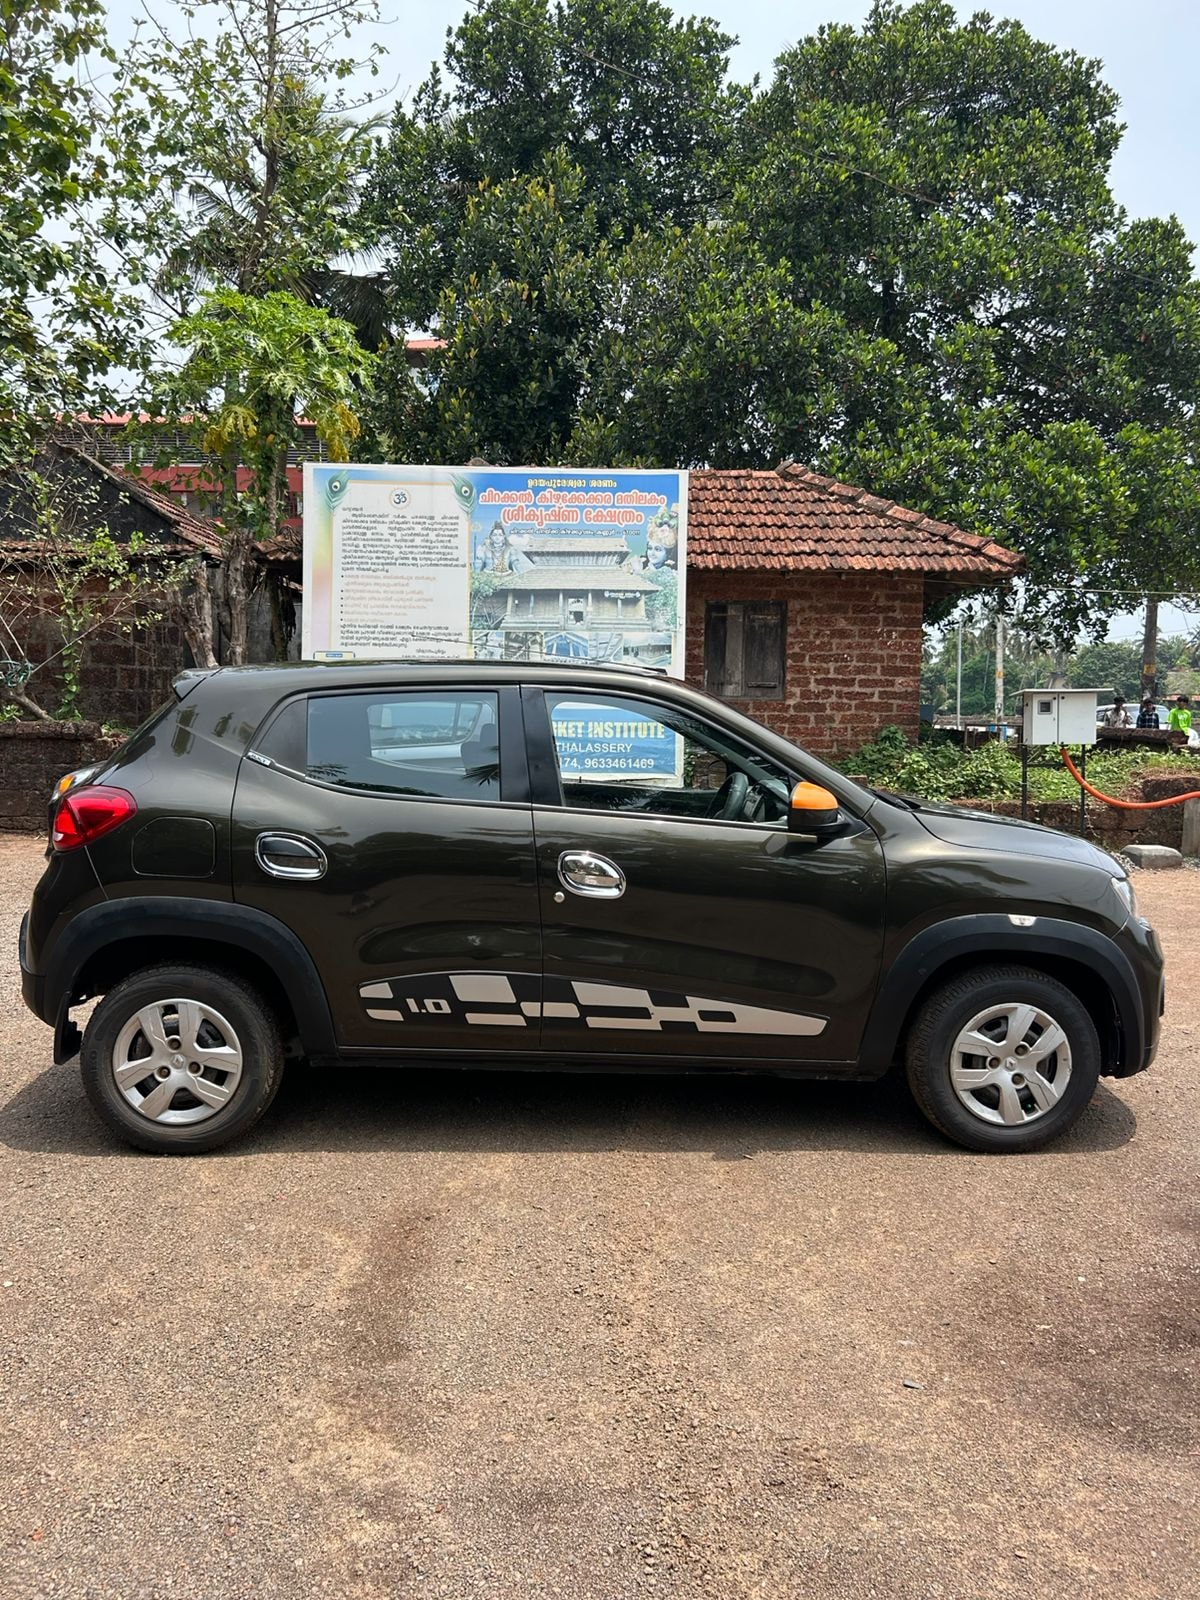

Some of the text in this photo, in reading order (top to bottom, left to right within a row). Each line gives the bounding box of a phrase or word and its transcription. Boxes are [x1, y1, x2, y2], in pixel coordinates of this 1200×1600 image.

[480, 489, 666, 505] ചിറക്കൽ കിഴക്കേക്കര മതിലകം
[502, 505, 644, 526] ശ്രീകൃഷ്ണ ക്ഷേത്രം
[588, 721, 665, 739] INSTITUTE
[556, 742, 633, 753] THALASSERY
[584, 758, 655, 769] 9633461469
[406, 998, 452, 1014] 1.0
